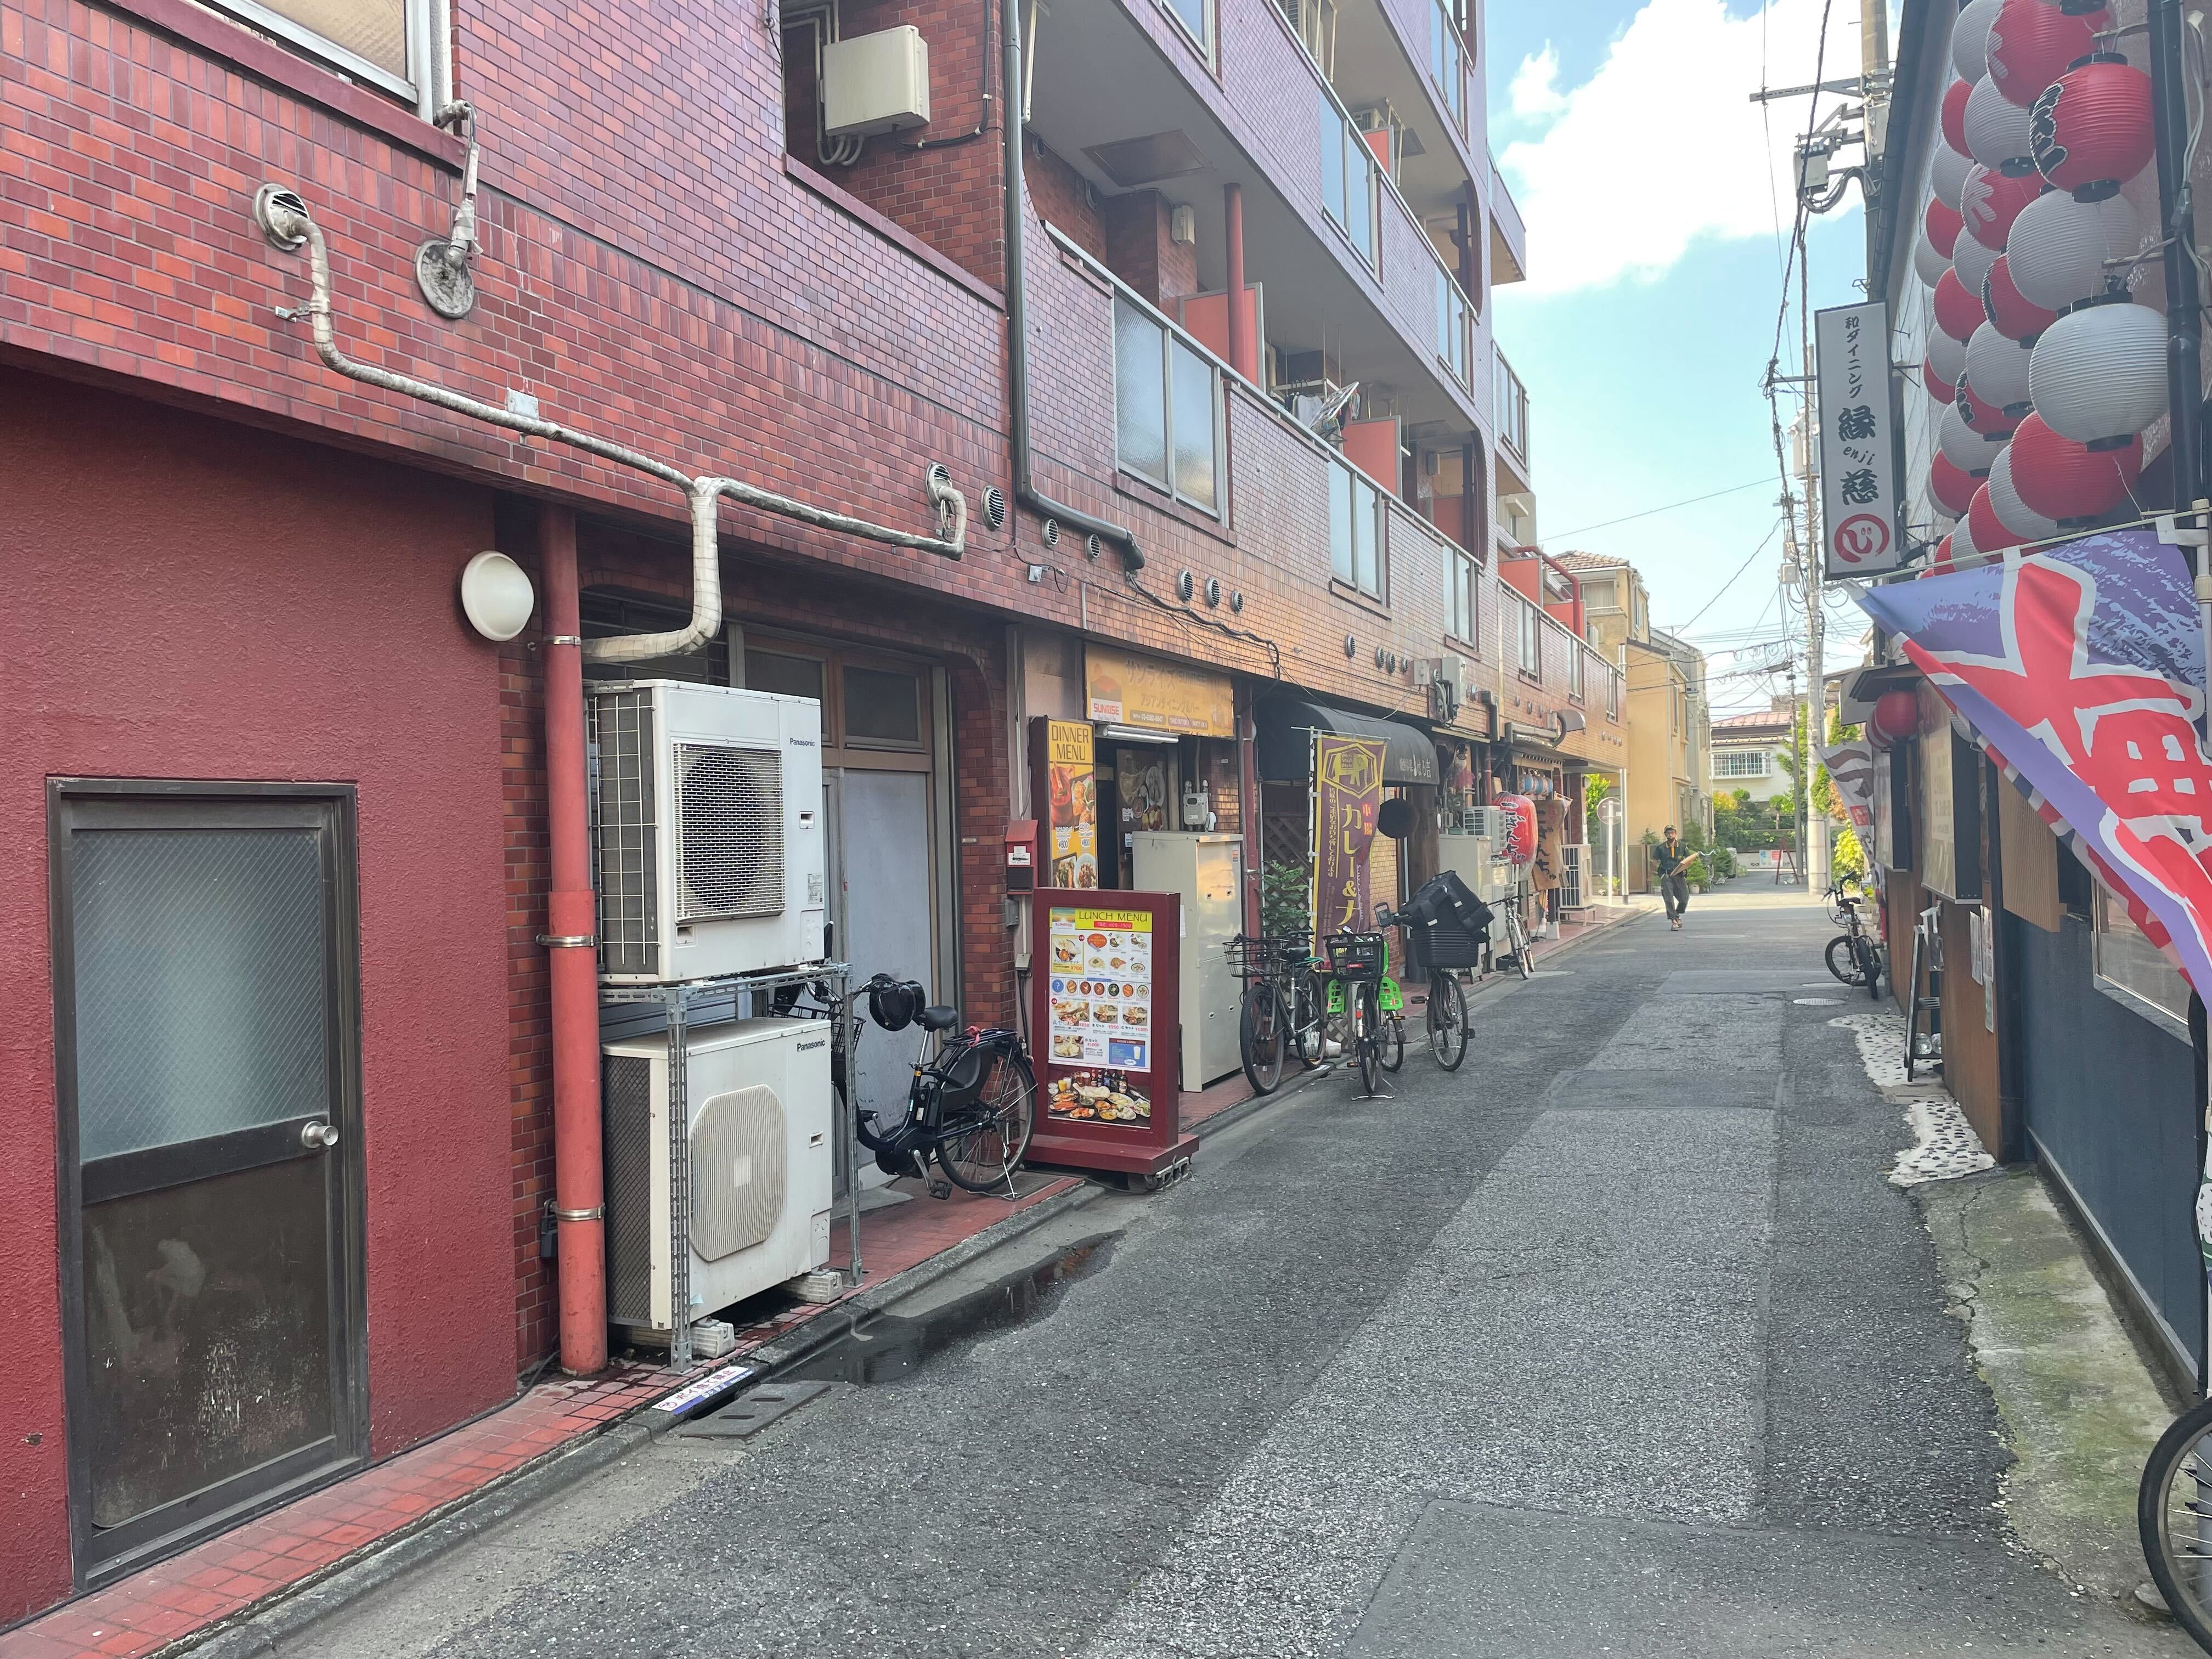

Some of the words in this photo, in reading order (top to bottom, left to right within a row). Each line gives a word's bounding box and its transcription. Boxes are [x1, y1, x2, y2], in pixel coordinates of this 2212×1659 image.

[1844, 316, 1863, 399] 和ダイニング
[1843, 445, 1876, 466] enji
[1126, 659, 1177, 691] サンライズ
[1093, 702, 1120, 715] SUNRISE
[789, 737, 815, 747] Panasonic
[1051, 725, 1089, 743] DINNER
[1057, 743, 1086, 760] MENU
[1335, 804, 1363, 935] カレー&ナ
[1079, 911, 1113, 921] LUNCH
[1118, 912, 1148, 922] MENU
[797, 1038, 826, 1052] Panasonic
[675, 1370, 737, 1400] ポイ捨て禁止
